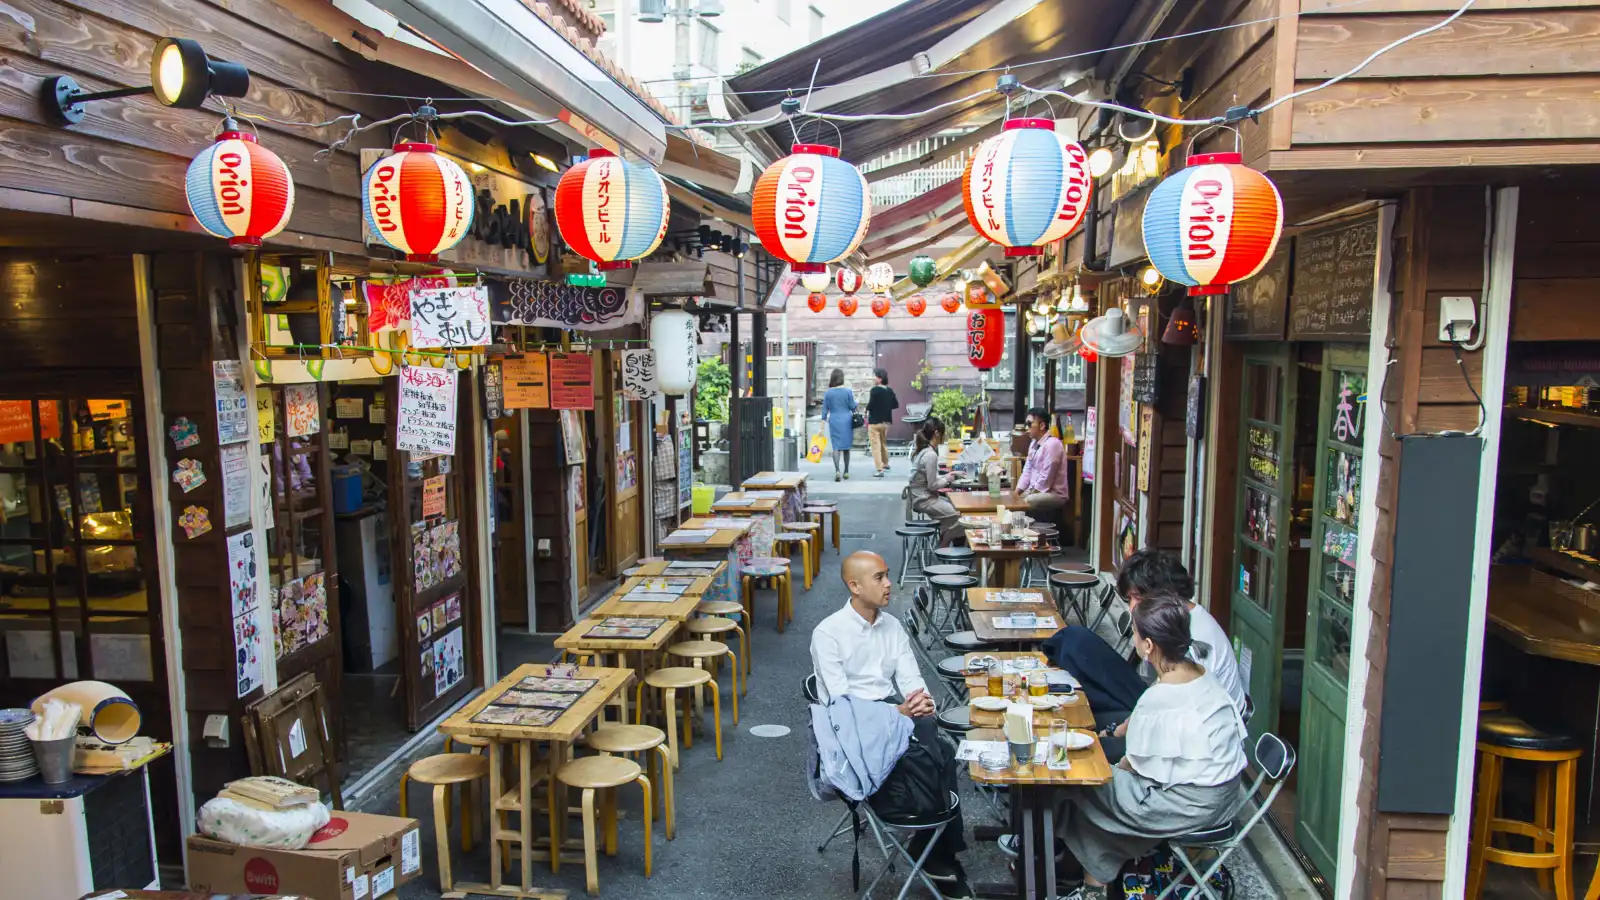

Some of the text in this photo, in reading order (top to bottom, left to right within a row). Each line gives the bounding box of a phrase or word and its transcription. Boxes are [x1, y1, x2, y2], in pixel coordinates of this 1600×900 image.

[219, 153, 248, 215] Orion
[374, 165, 397, 232] Orion
[598, 160, 612, 244] オリオンビール
[784, 166, 816, 239] Orion
[1057, 143, 1088, 221] Orion
[1188, 179, 1226, 261] Orion
[969, 312, 986, 360] おでん
[246, 870, 277, 887] Swift
